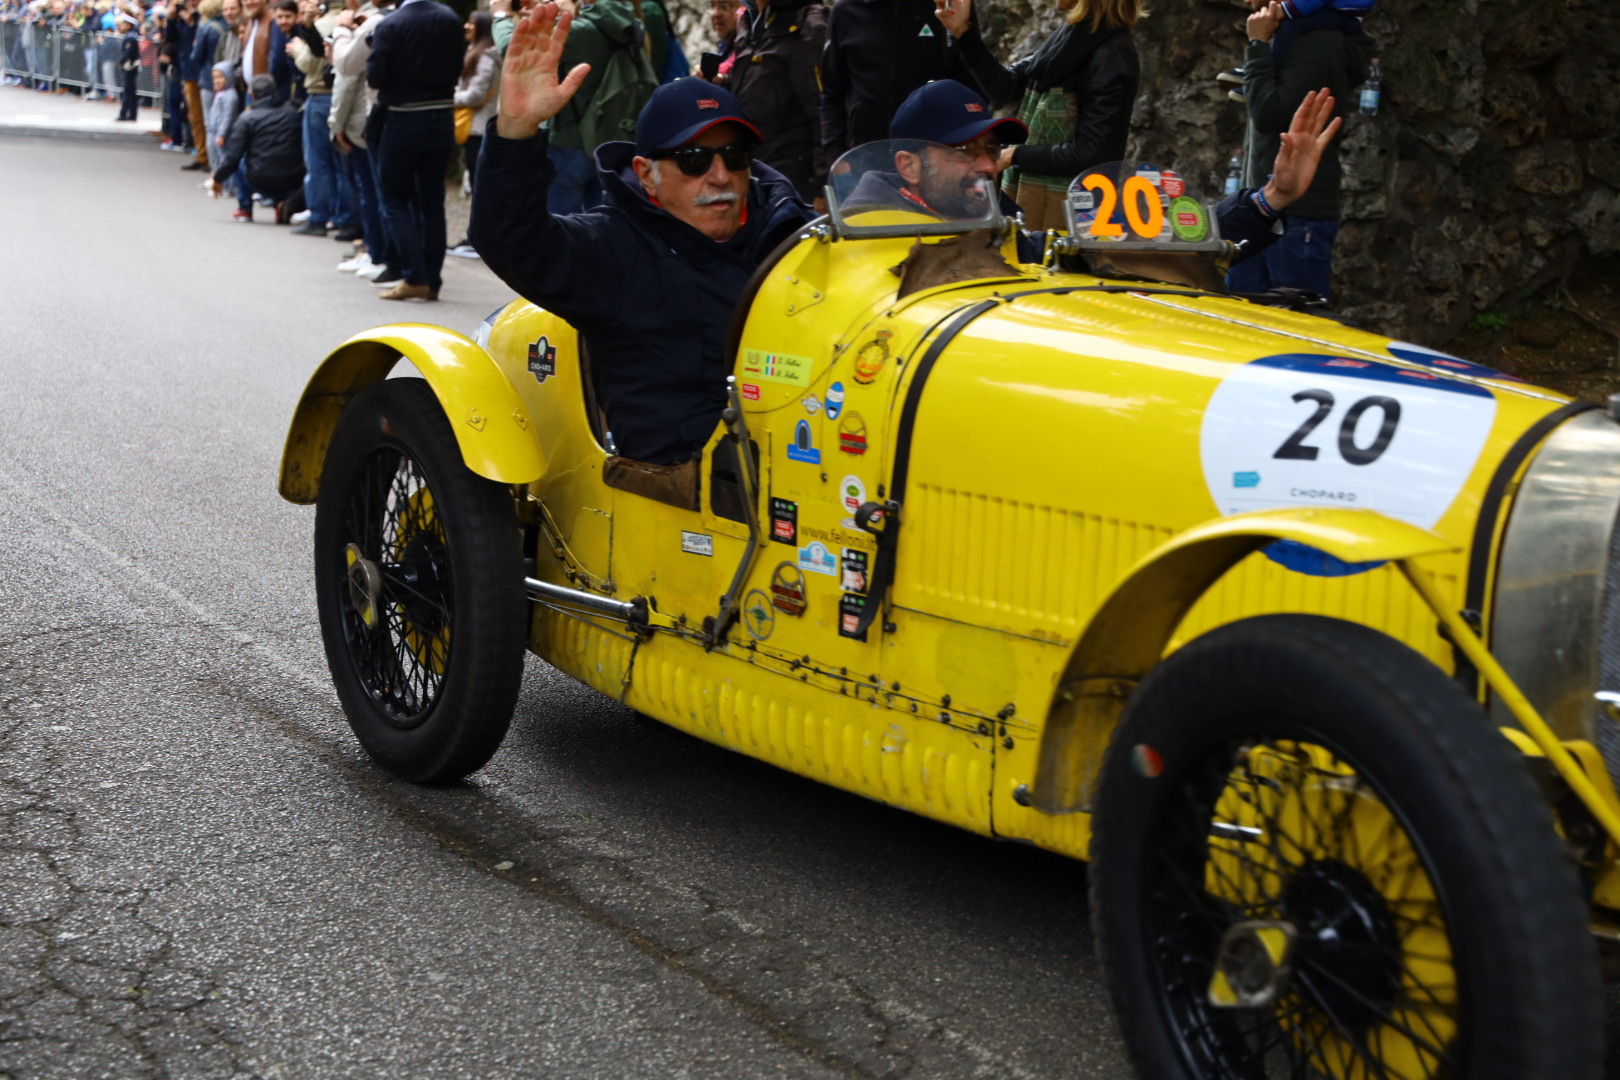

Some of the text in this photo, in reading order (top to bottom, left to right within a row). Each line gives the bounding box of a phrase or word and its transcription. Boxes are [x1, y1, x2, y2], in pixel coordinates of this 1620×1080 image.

[1081, 173, 1163, 239] 20
[1271, 387, 1402, 466] 20
[1290, 488, 1357, 502] CHOPARD
